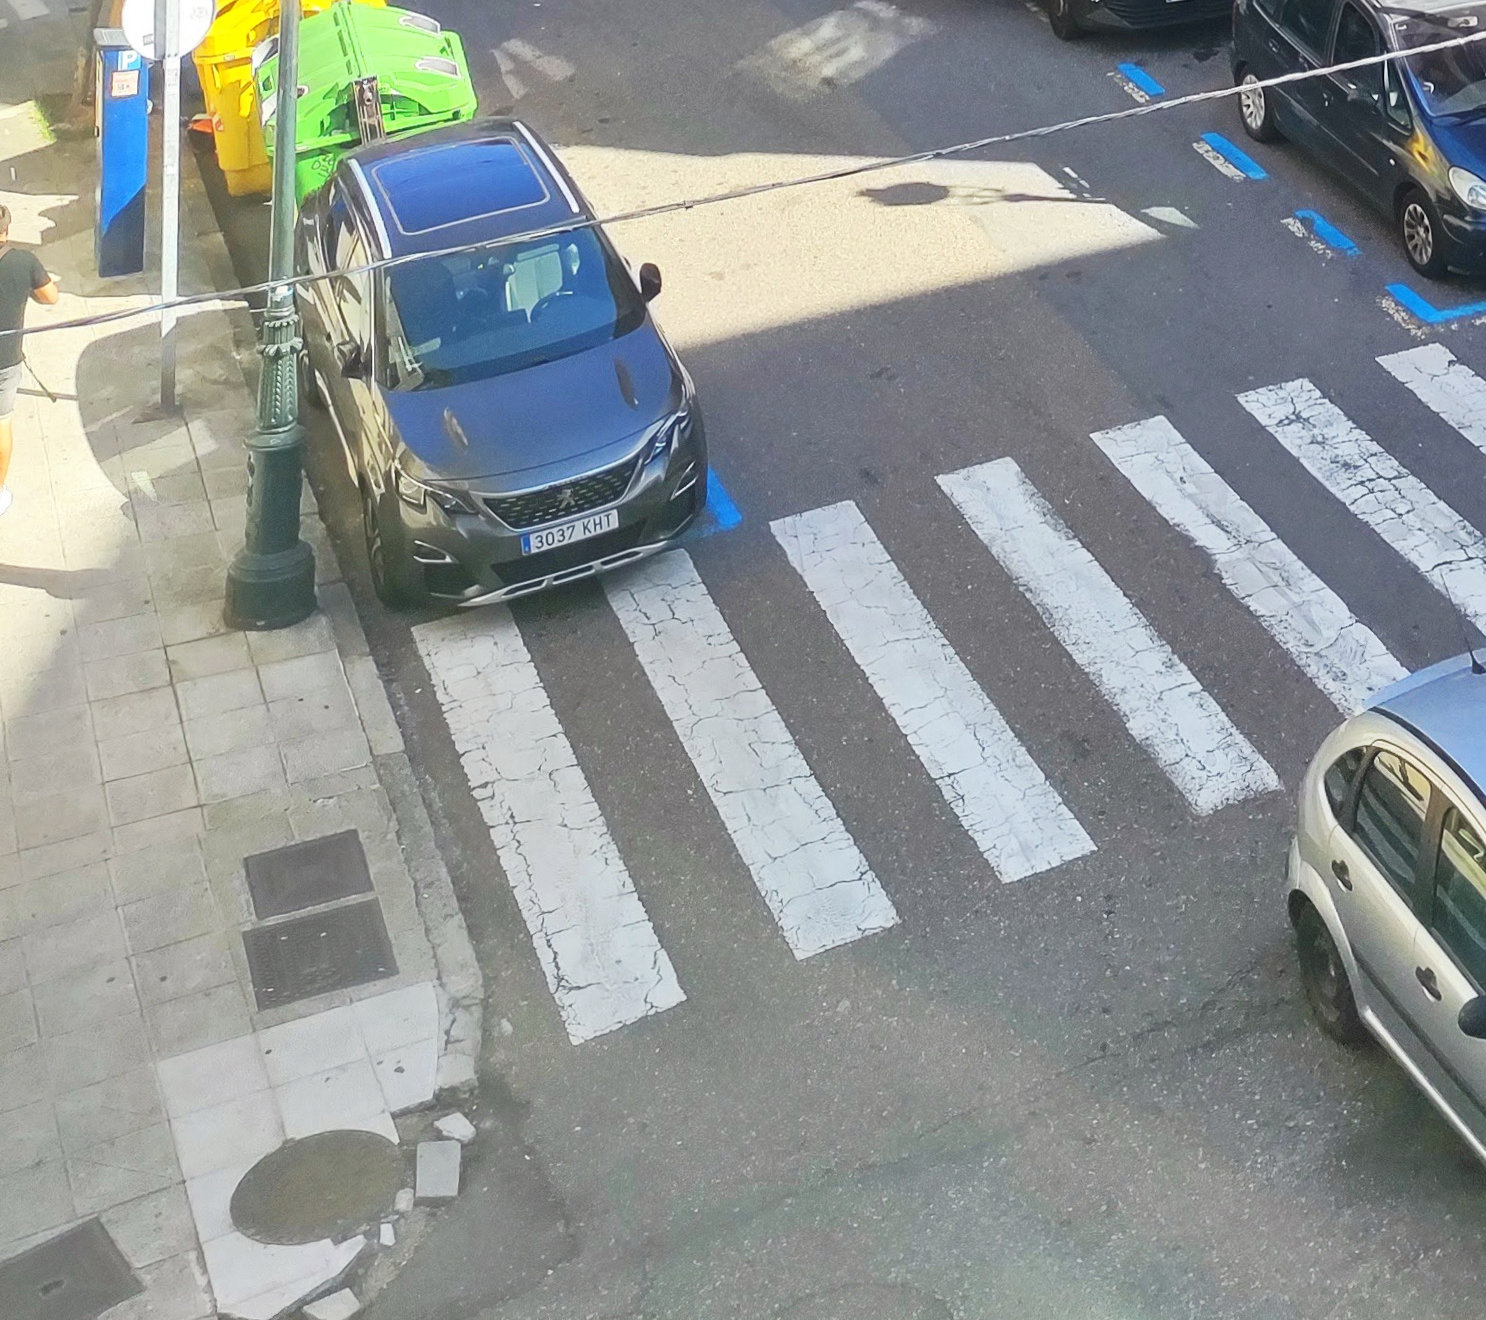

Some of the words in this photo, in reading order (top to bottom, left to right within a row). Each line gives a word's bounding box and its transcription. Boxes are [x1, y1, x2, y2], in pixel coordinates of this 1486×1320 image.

[121, 50, 138, 69] P
[535, 525, 576, 550] 3037
[582, 512, 613, 536] KHT
